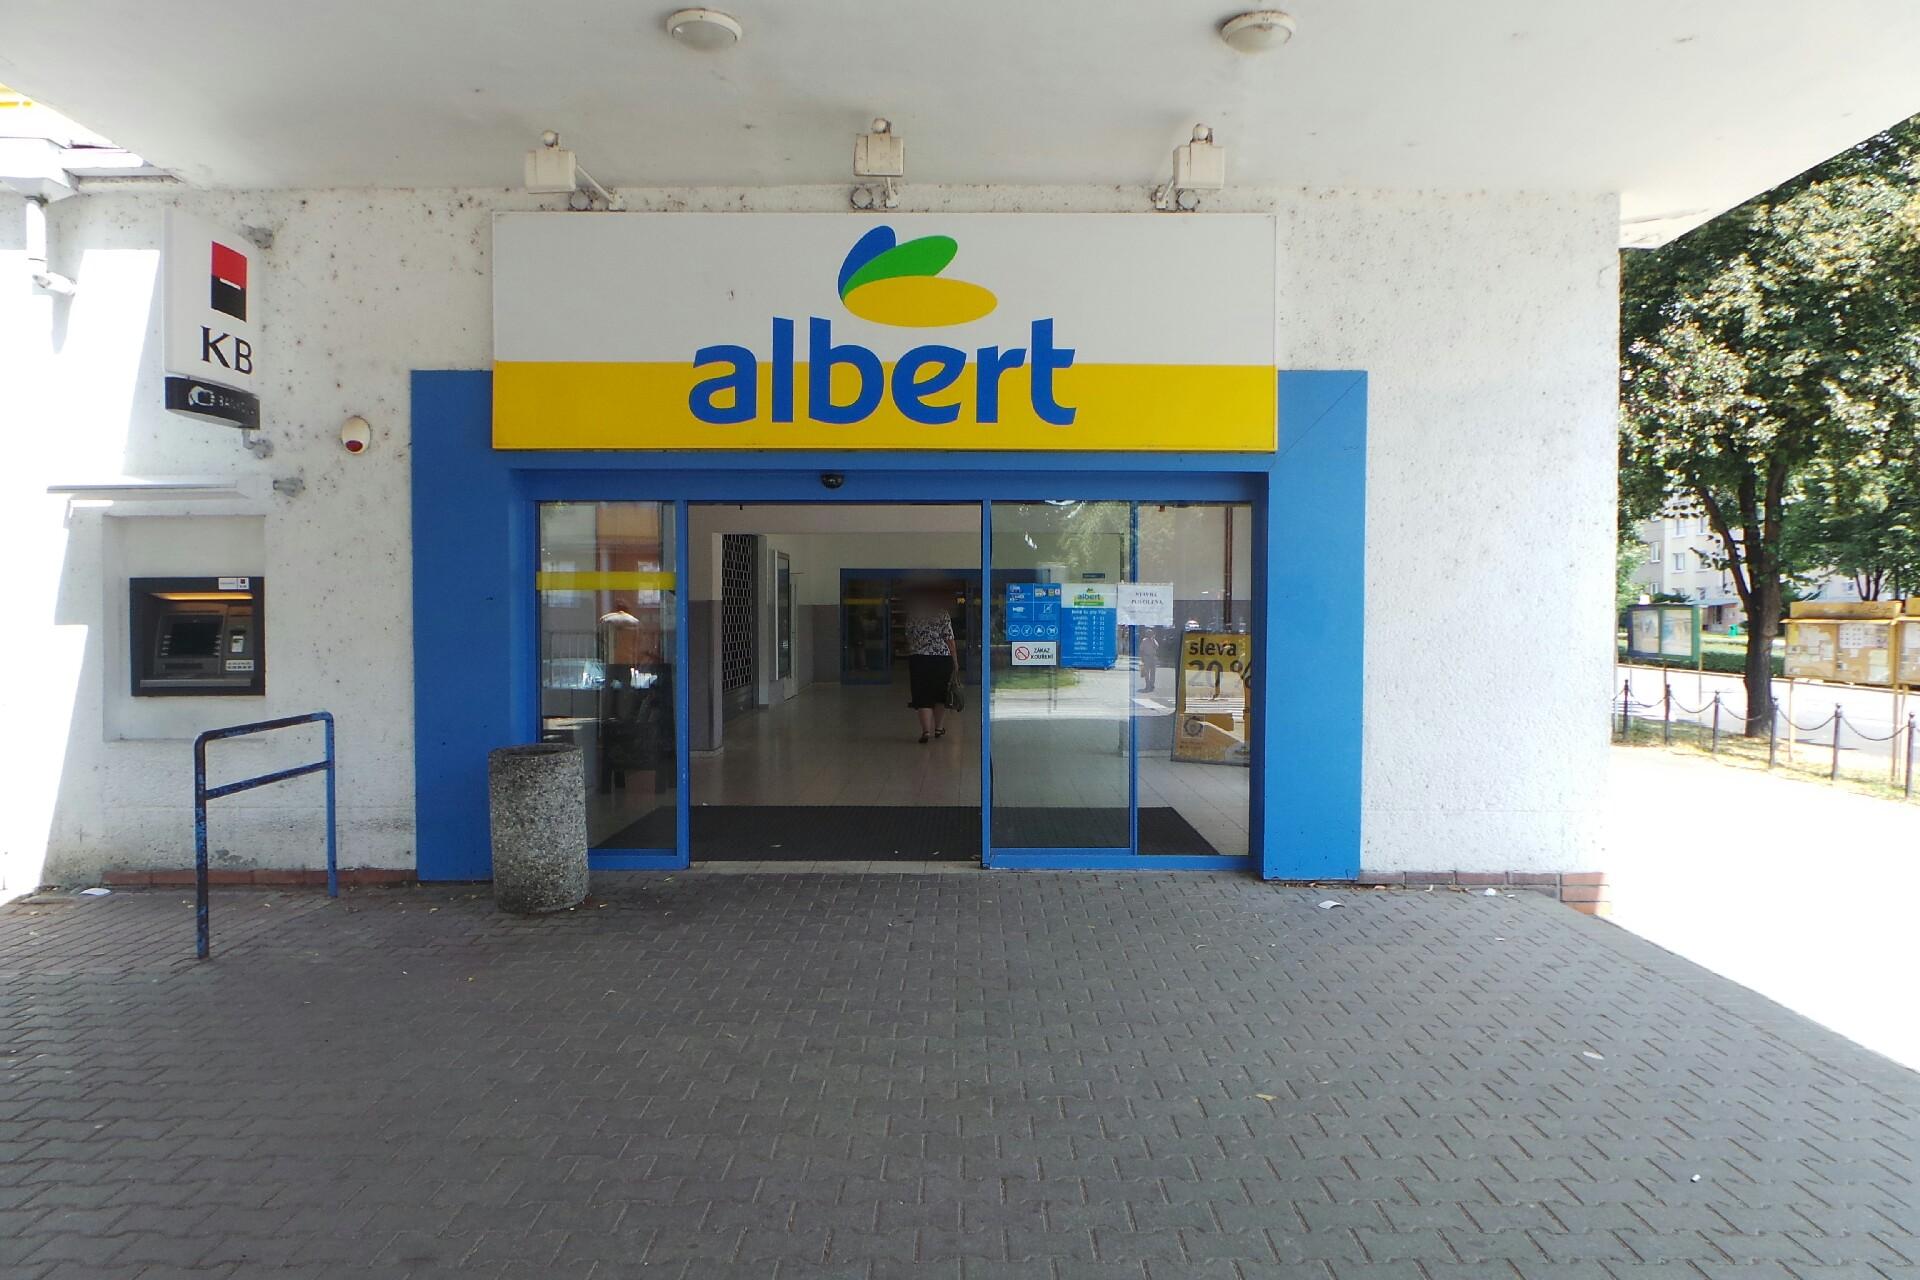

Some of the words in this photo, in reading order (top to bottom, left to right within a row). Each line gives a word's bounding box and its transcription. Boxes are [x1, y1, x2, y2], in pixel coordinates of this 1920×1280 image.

[200, 325, 253, 375] KB
[689, 316, 1077, 425] albert
[1188, 638, 1237, 656] sleva
